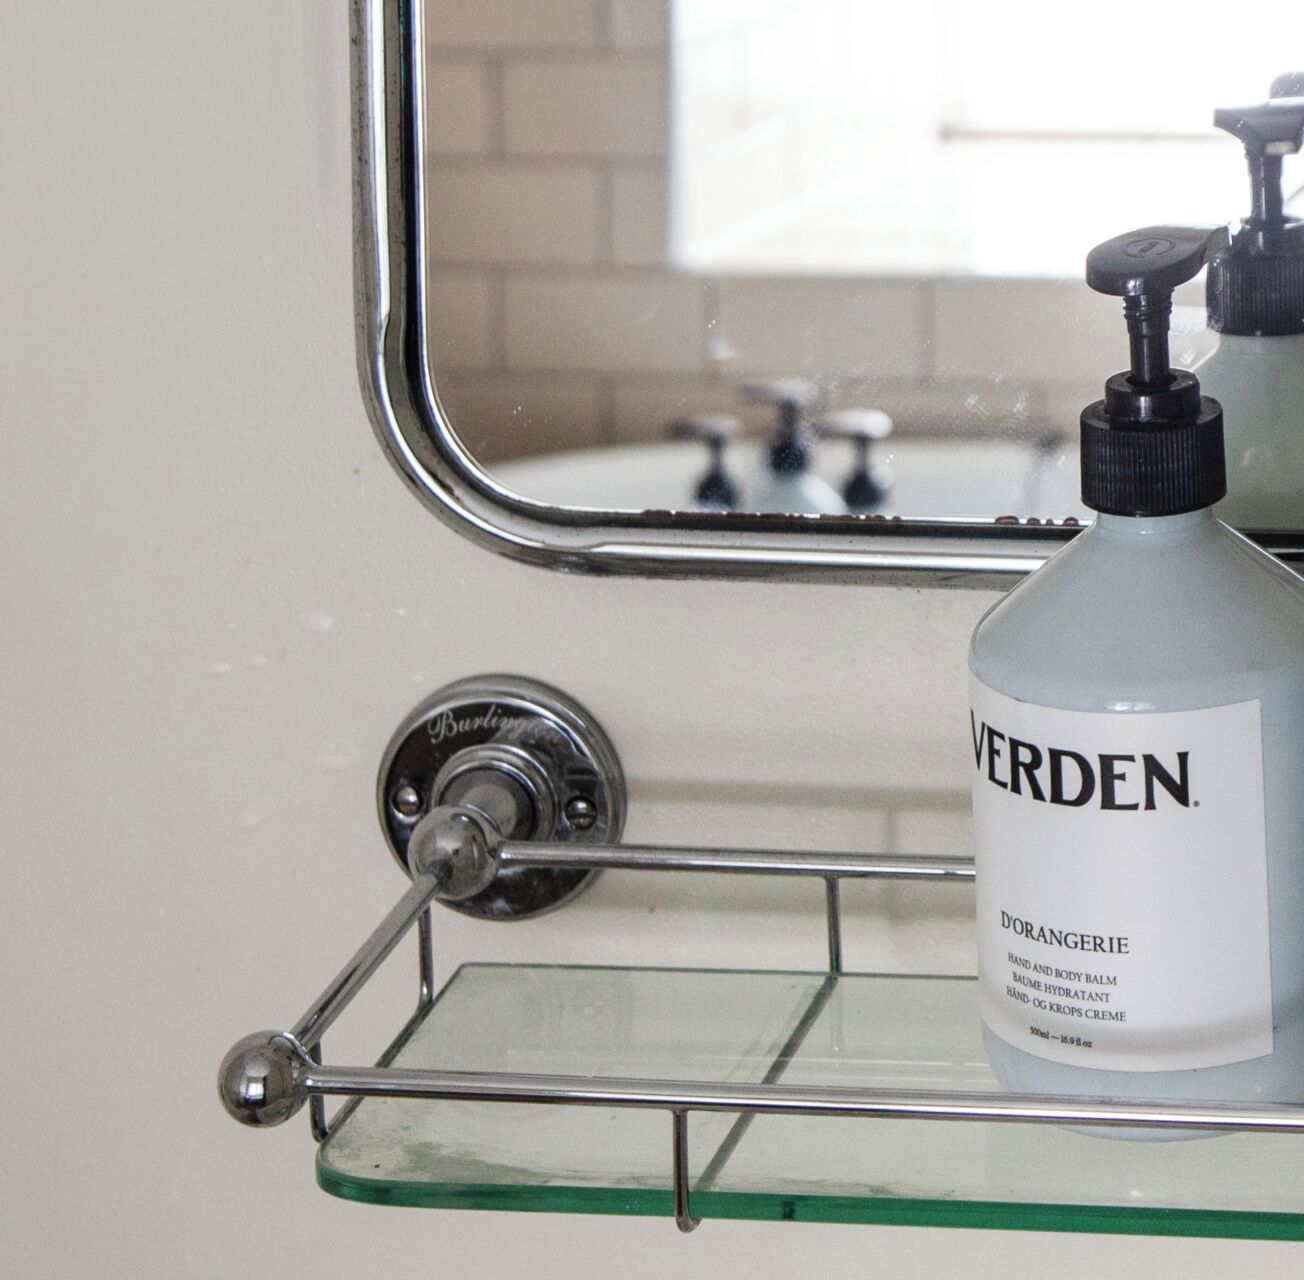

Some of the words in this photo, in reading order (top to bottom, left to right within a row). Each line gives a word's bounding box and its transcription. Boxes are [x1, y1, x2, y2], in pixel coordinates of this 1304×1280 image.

[1001, 910, 1129, 954] D'ORANGERIE
[1008, 952, 1031, 970] HAND
[1032, 963, 1053, 976] AND
[1055, 968, 1083, 982] BODY
[1085, 973, 1117, 986] BALM
[1013, 972, 1042, 991] BAUME
[1044, 983, 1111, 1003] HYDRATANT
[1033, 997, 1047, 1010] OG
[1049, 1002, 1083, 1018] KROPS
[1085, 1009, 1127, 1022] CREME
